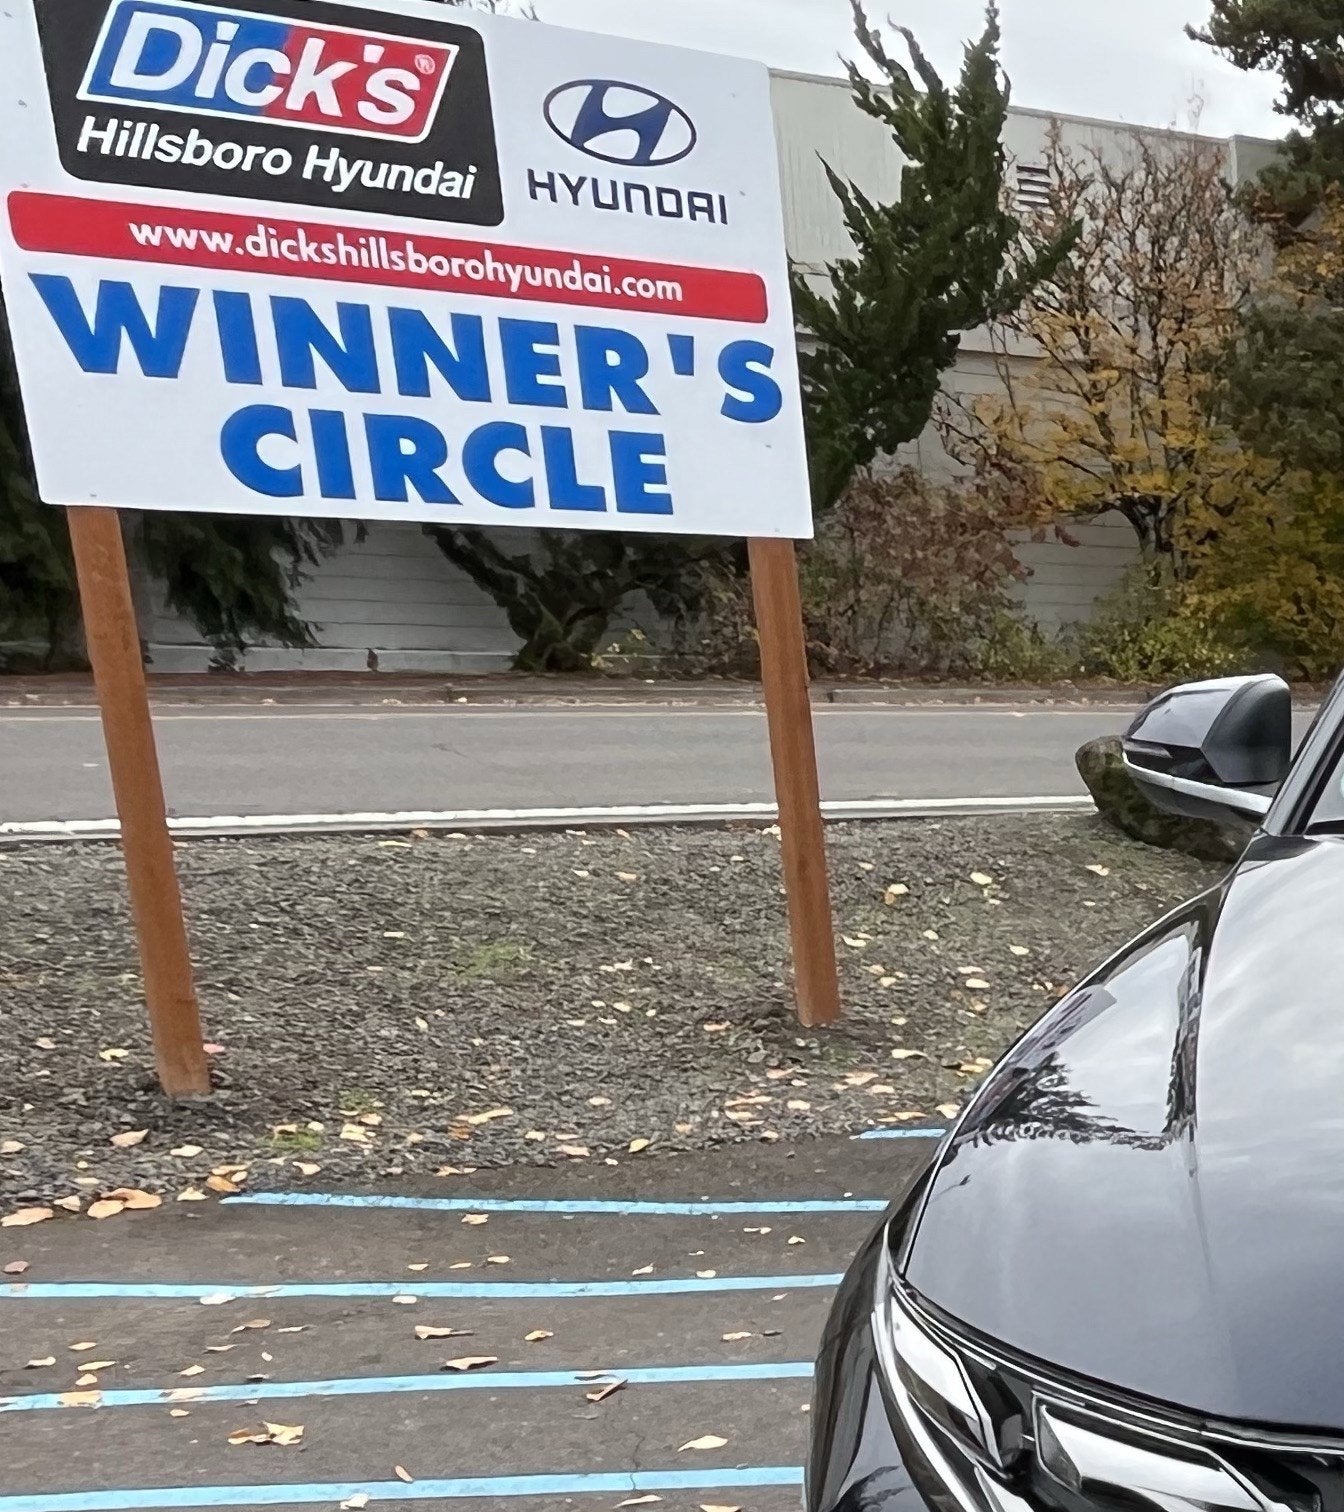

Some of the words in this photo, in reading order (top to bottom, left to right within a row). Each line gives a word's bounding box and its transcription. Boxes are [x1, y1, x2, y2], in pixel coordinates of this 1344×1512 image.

[108, 9, 422, 126] Dick's
[77, 116, 293, 176] Hillsboro
[303, 147, 479, 201] Hyundai
[527, 169, 729, 226] HYUNDAI
[129, 220, 684, 303] www.dickshillsborohyundai.com
[28, 272, 783, 425] WINNER'S
[220, 404, 675, 516] CIRCLE
